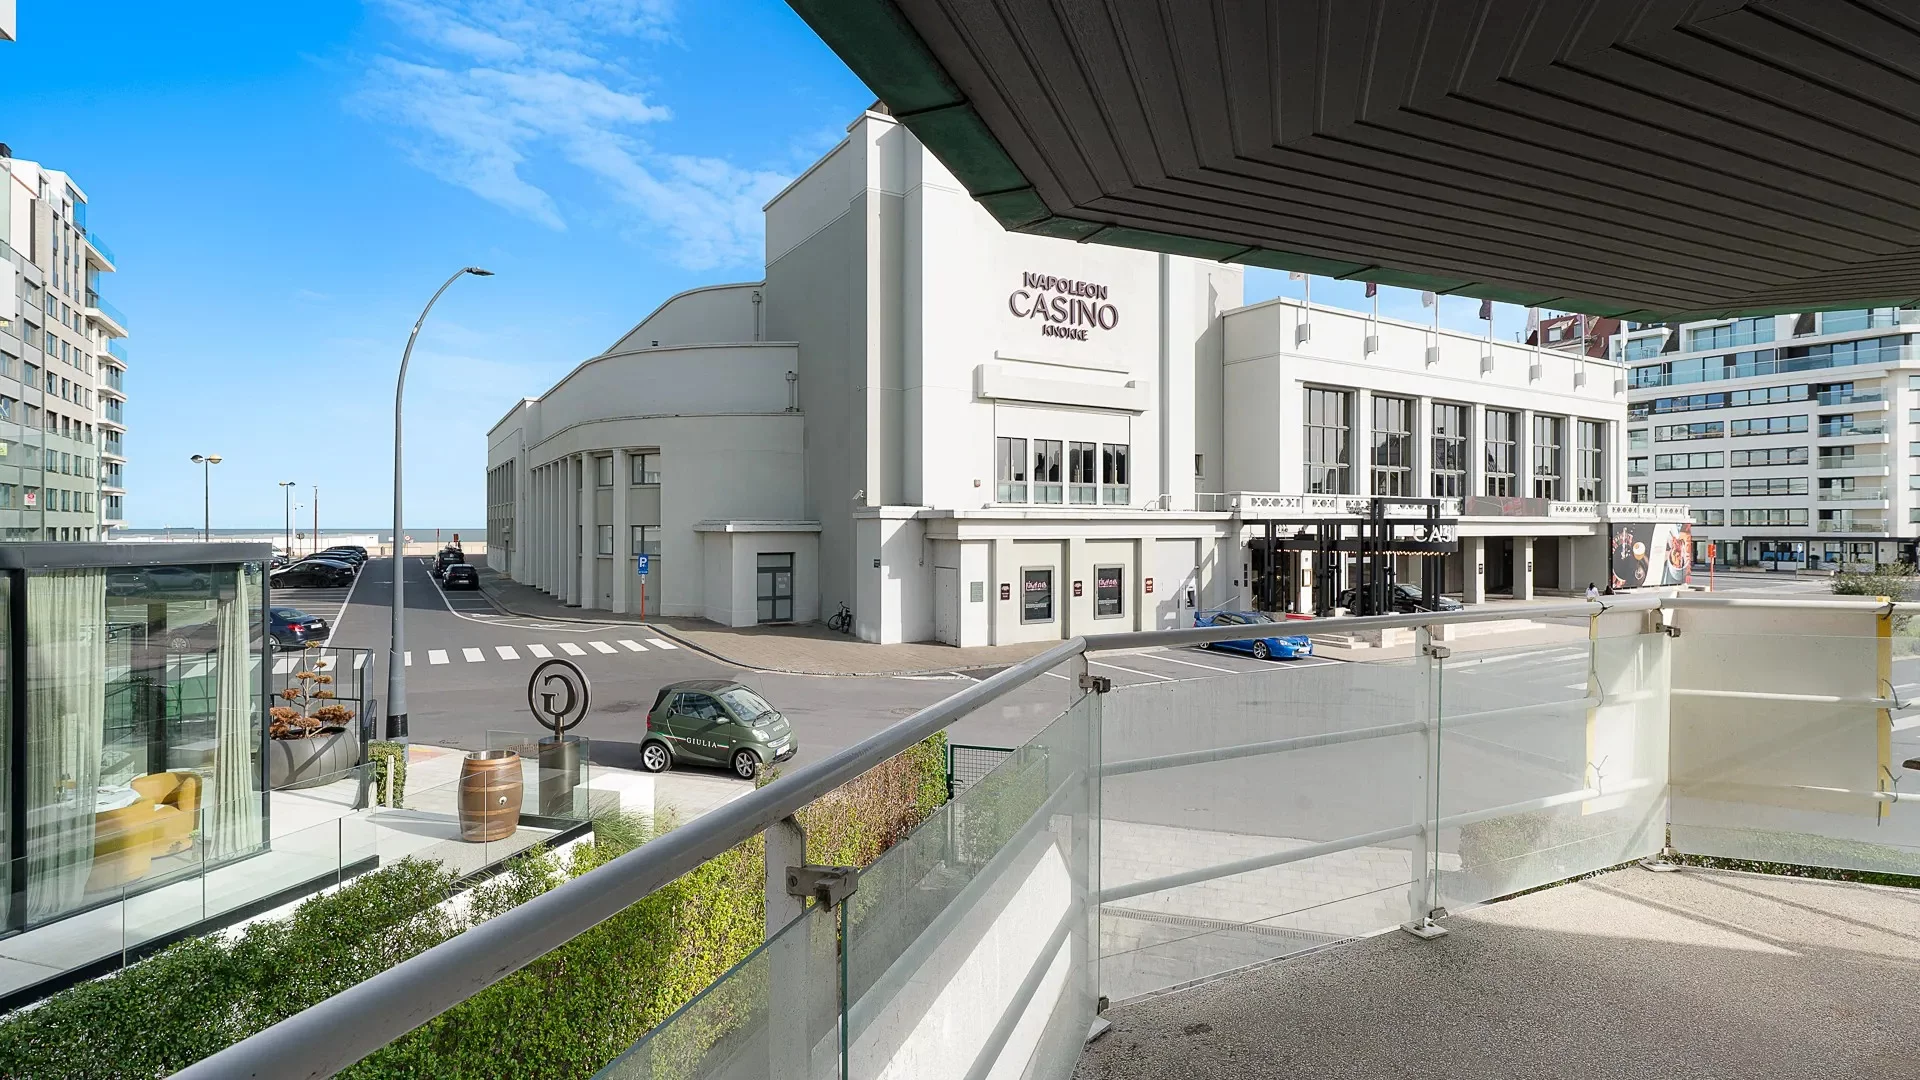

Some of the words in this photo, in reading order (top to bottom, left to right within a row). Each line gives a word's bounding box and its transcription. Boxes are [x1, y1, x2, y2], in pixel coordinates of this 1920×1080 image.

[1023, 271, 1108, 300] NAPOLEON
[1009, 290, 1119, 330] CASINO
[1042, 324, 1089, 341] KNOKKE
[639, 557, 648, 568] P
[686, 736, 717, 749] GIULIA
